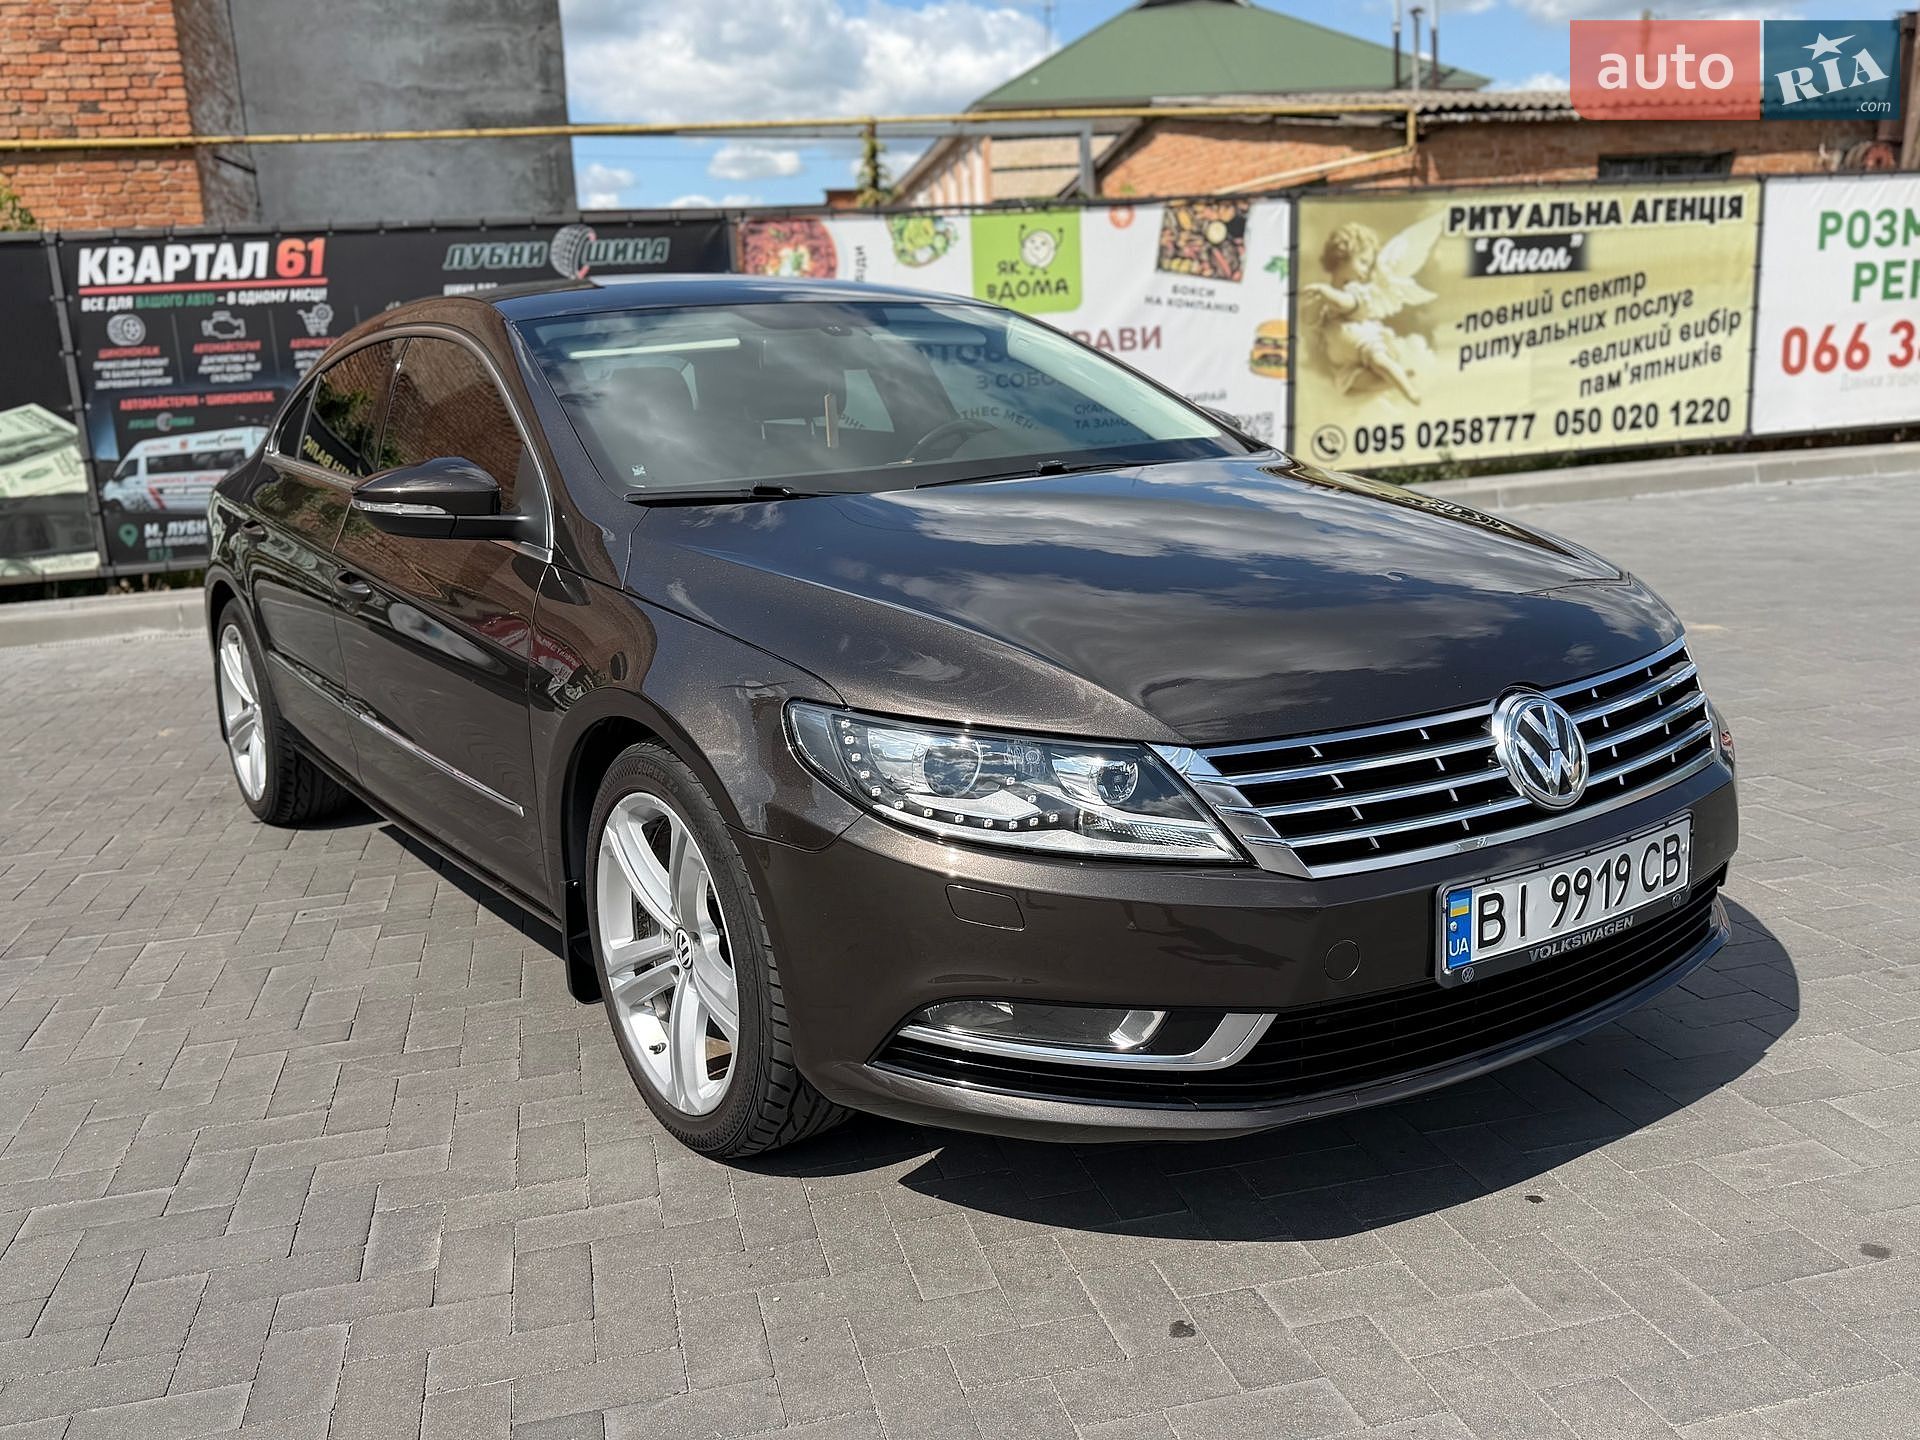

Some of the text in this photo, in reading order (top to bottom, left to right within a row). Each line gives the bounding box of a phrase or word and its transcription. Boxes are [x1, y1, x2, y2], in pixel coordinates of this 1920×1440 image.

[1449, 195, 1744, 232] РИТУАЛЬНА АГЕНЦІЯ
[1818, 208, 1920, 252] РОЗМ
[78, 237, 326, 286] КВАРТАЛ 61
[442, 237, 671, 270] ЛУБНИ ШИНА
[997, 260, 1021, 276] ЯК
[81, 296, 104, 313] ВСЕ
[106, 295, 134, 311] ДЛЯ
[135, 293, 183, 310] ВАШОГО
[185, 292, 215, 308] АВТО
[237, 288, 287, 305] ОДНОМУ
[1143, 294, 1163, 306] НА
[1455, 272, 1648, 334] -повний спектр
[1459, 287, 1695, 371] ритуальних послуг
[1569, 308, 1742, 369] -великий вибір
[1781, 319, 1920, 376] 066 3
[1354, 397, 1732, 454] 095 0258777 050 020 1220
[144, 520, 207, 539] М. ЛУБН
[1477, 833, 1681, 950] BI 9919 CB
[1448, 937, 1470, 957] UA
[1528, 914, 1635, 962] VOLKSWAGEN
